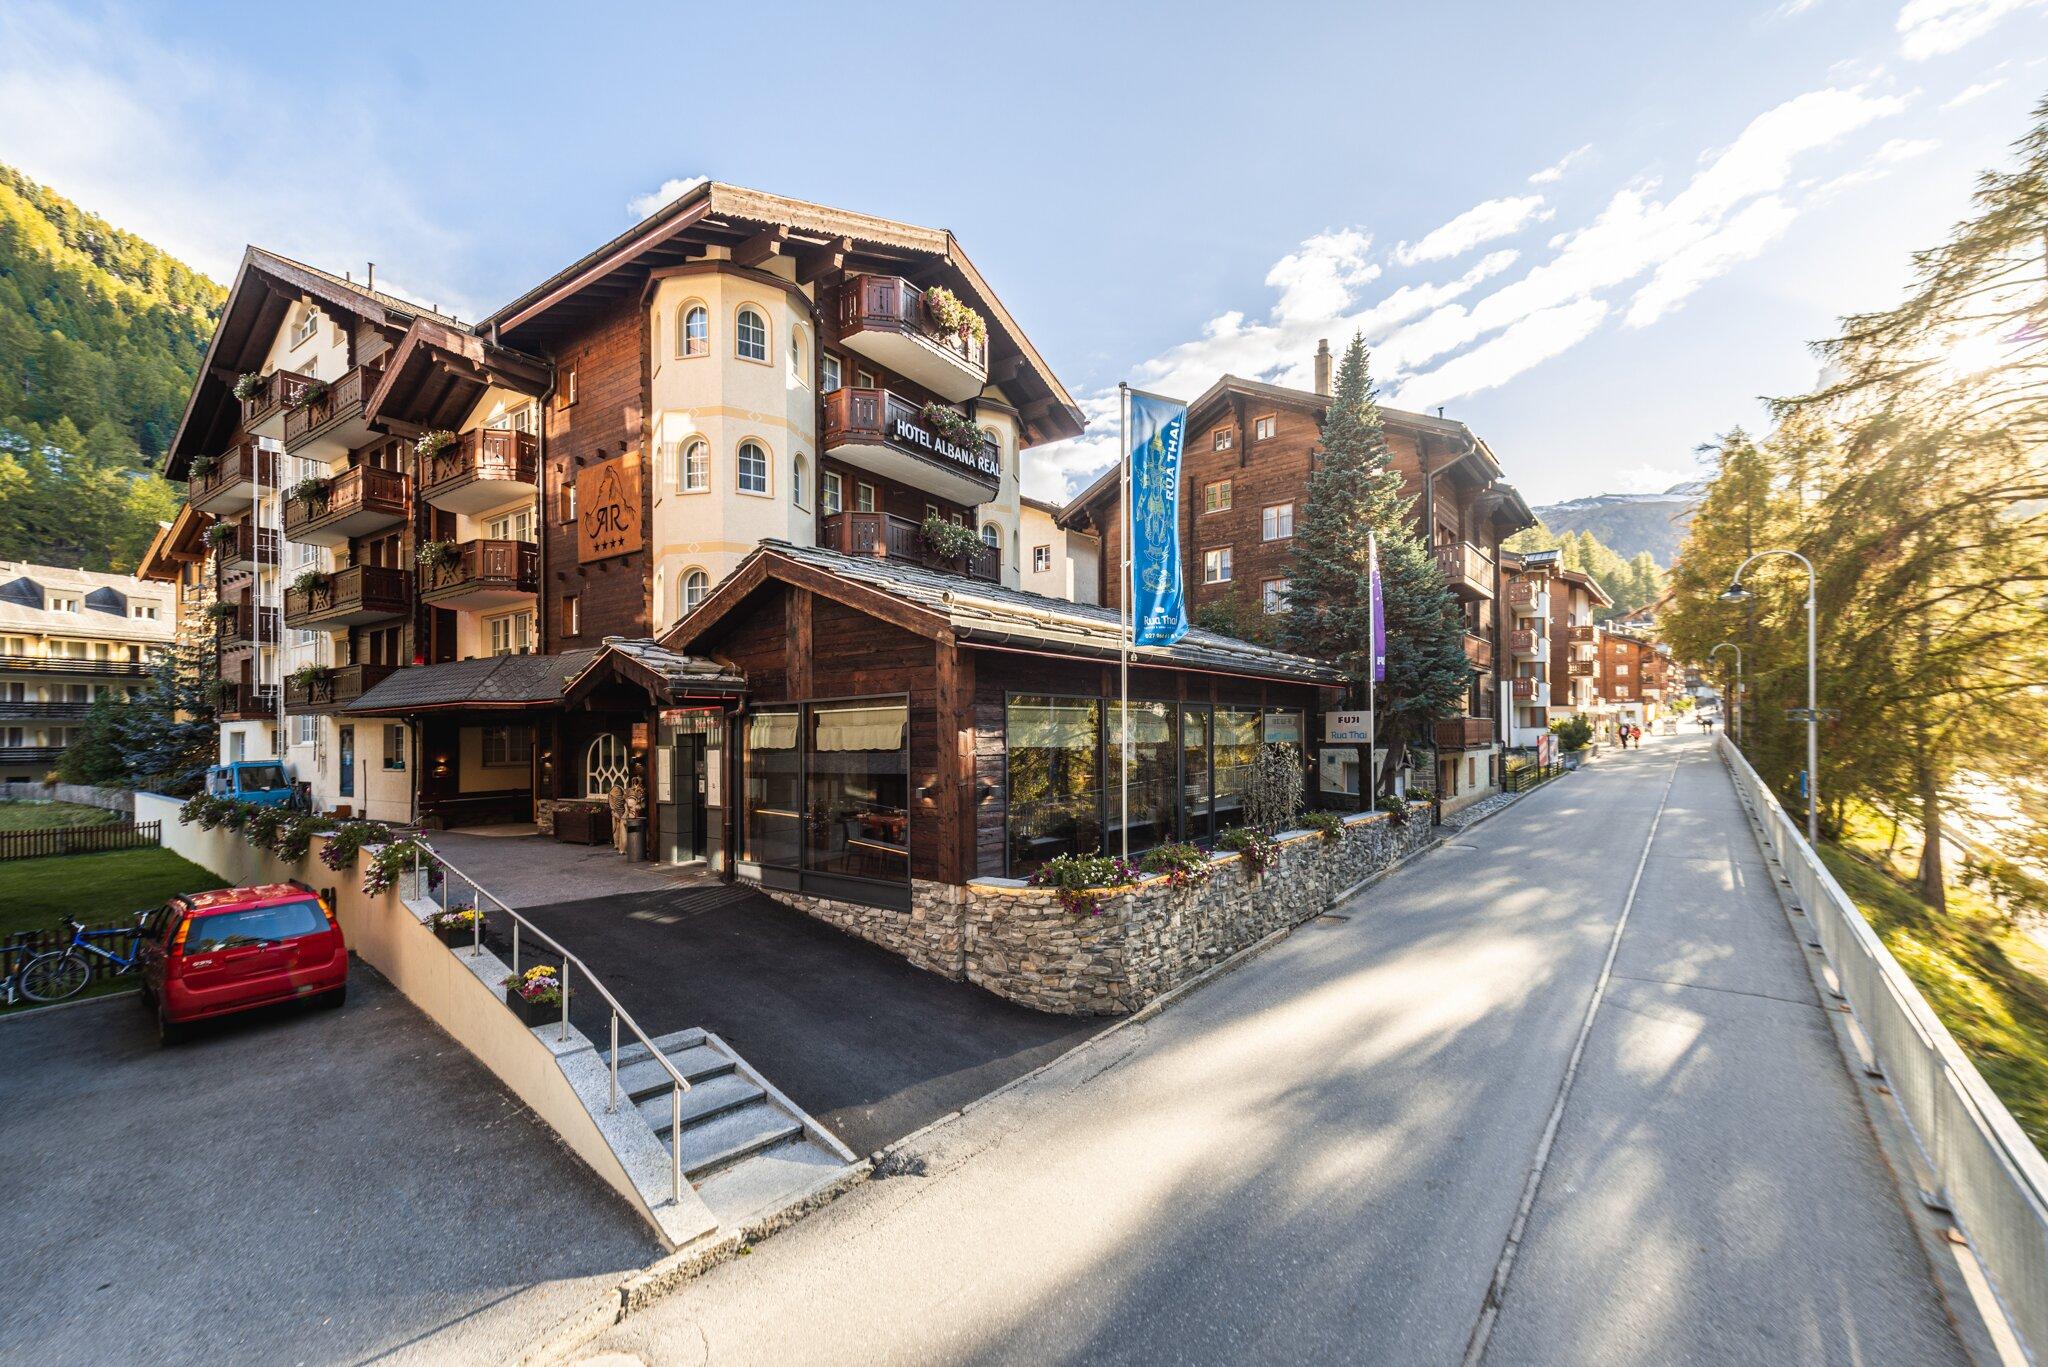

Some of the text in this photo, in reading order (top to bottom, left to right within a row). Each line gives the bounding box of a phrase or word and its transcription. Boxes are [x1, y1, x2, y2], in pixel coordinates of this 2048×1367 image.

[896, 418, 1001, 477] HOTEL ALBANA REAL
[1165, 421, 1181, 501] RUA THAI
[1143, 614, 1178, 626] Rua Thai
[1337, 716, 1360, 724] FUJI
[1331, 730, 1367, 740] Rua Thai
